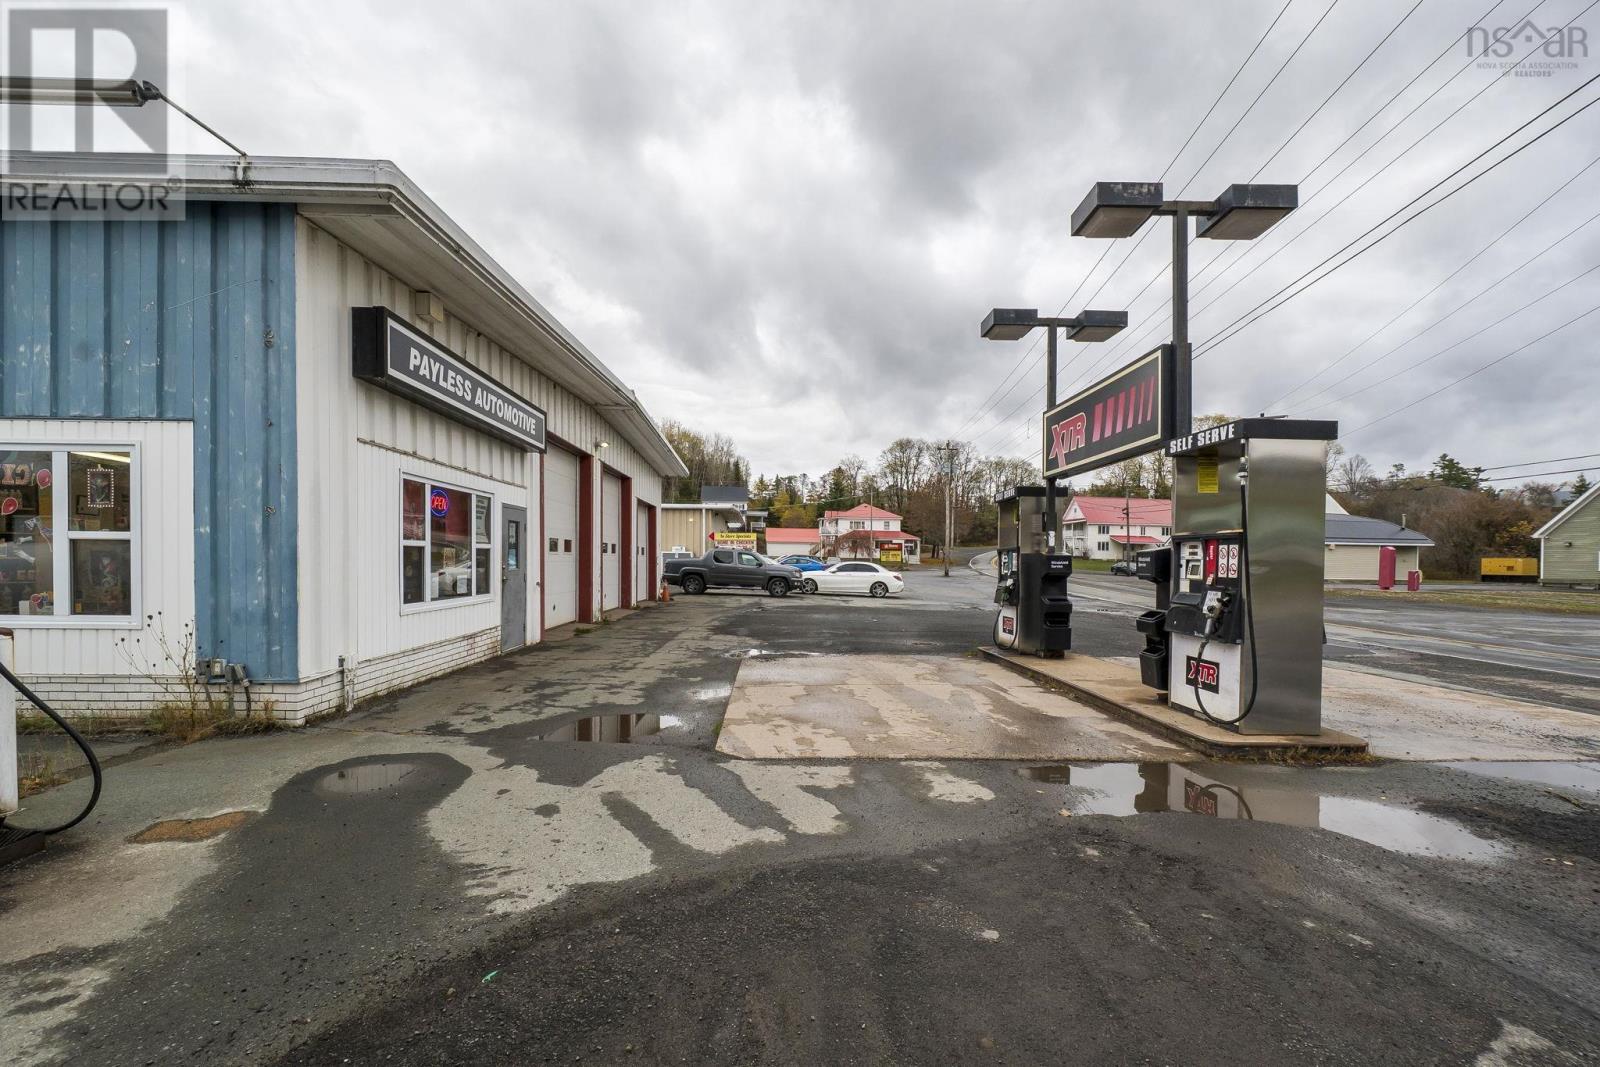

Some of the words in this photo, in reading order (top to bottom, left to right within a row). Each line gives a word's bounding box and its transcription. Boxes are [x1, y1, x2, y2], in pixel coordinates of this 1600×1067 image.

[408, 347, 472, 402] PAYLESS
[475, 386, 537, 435] AUTOMOTIVE
[1049, 412, 1087, 468] XTR
[1169, 435, 1193, 454] SELF
[1197, 424, 1235, 447] SERVE
[431, 496, 448, 510] OPEN
[1188, 660, 1218, 687] XTR
